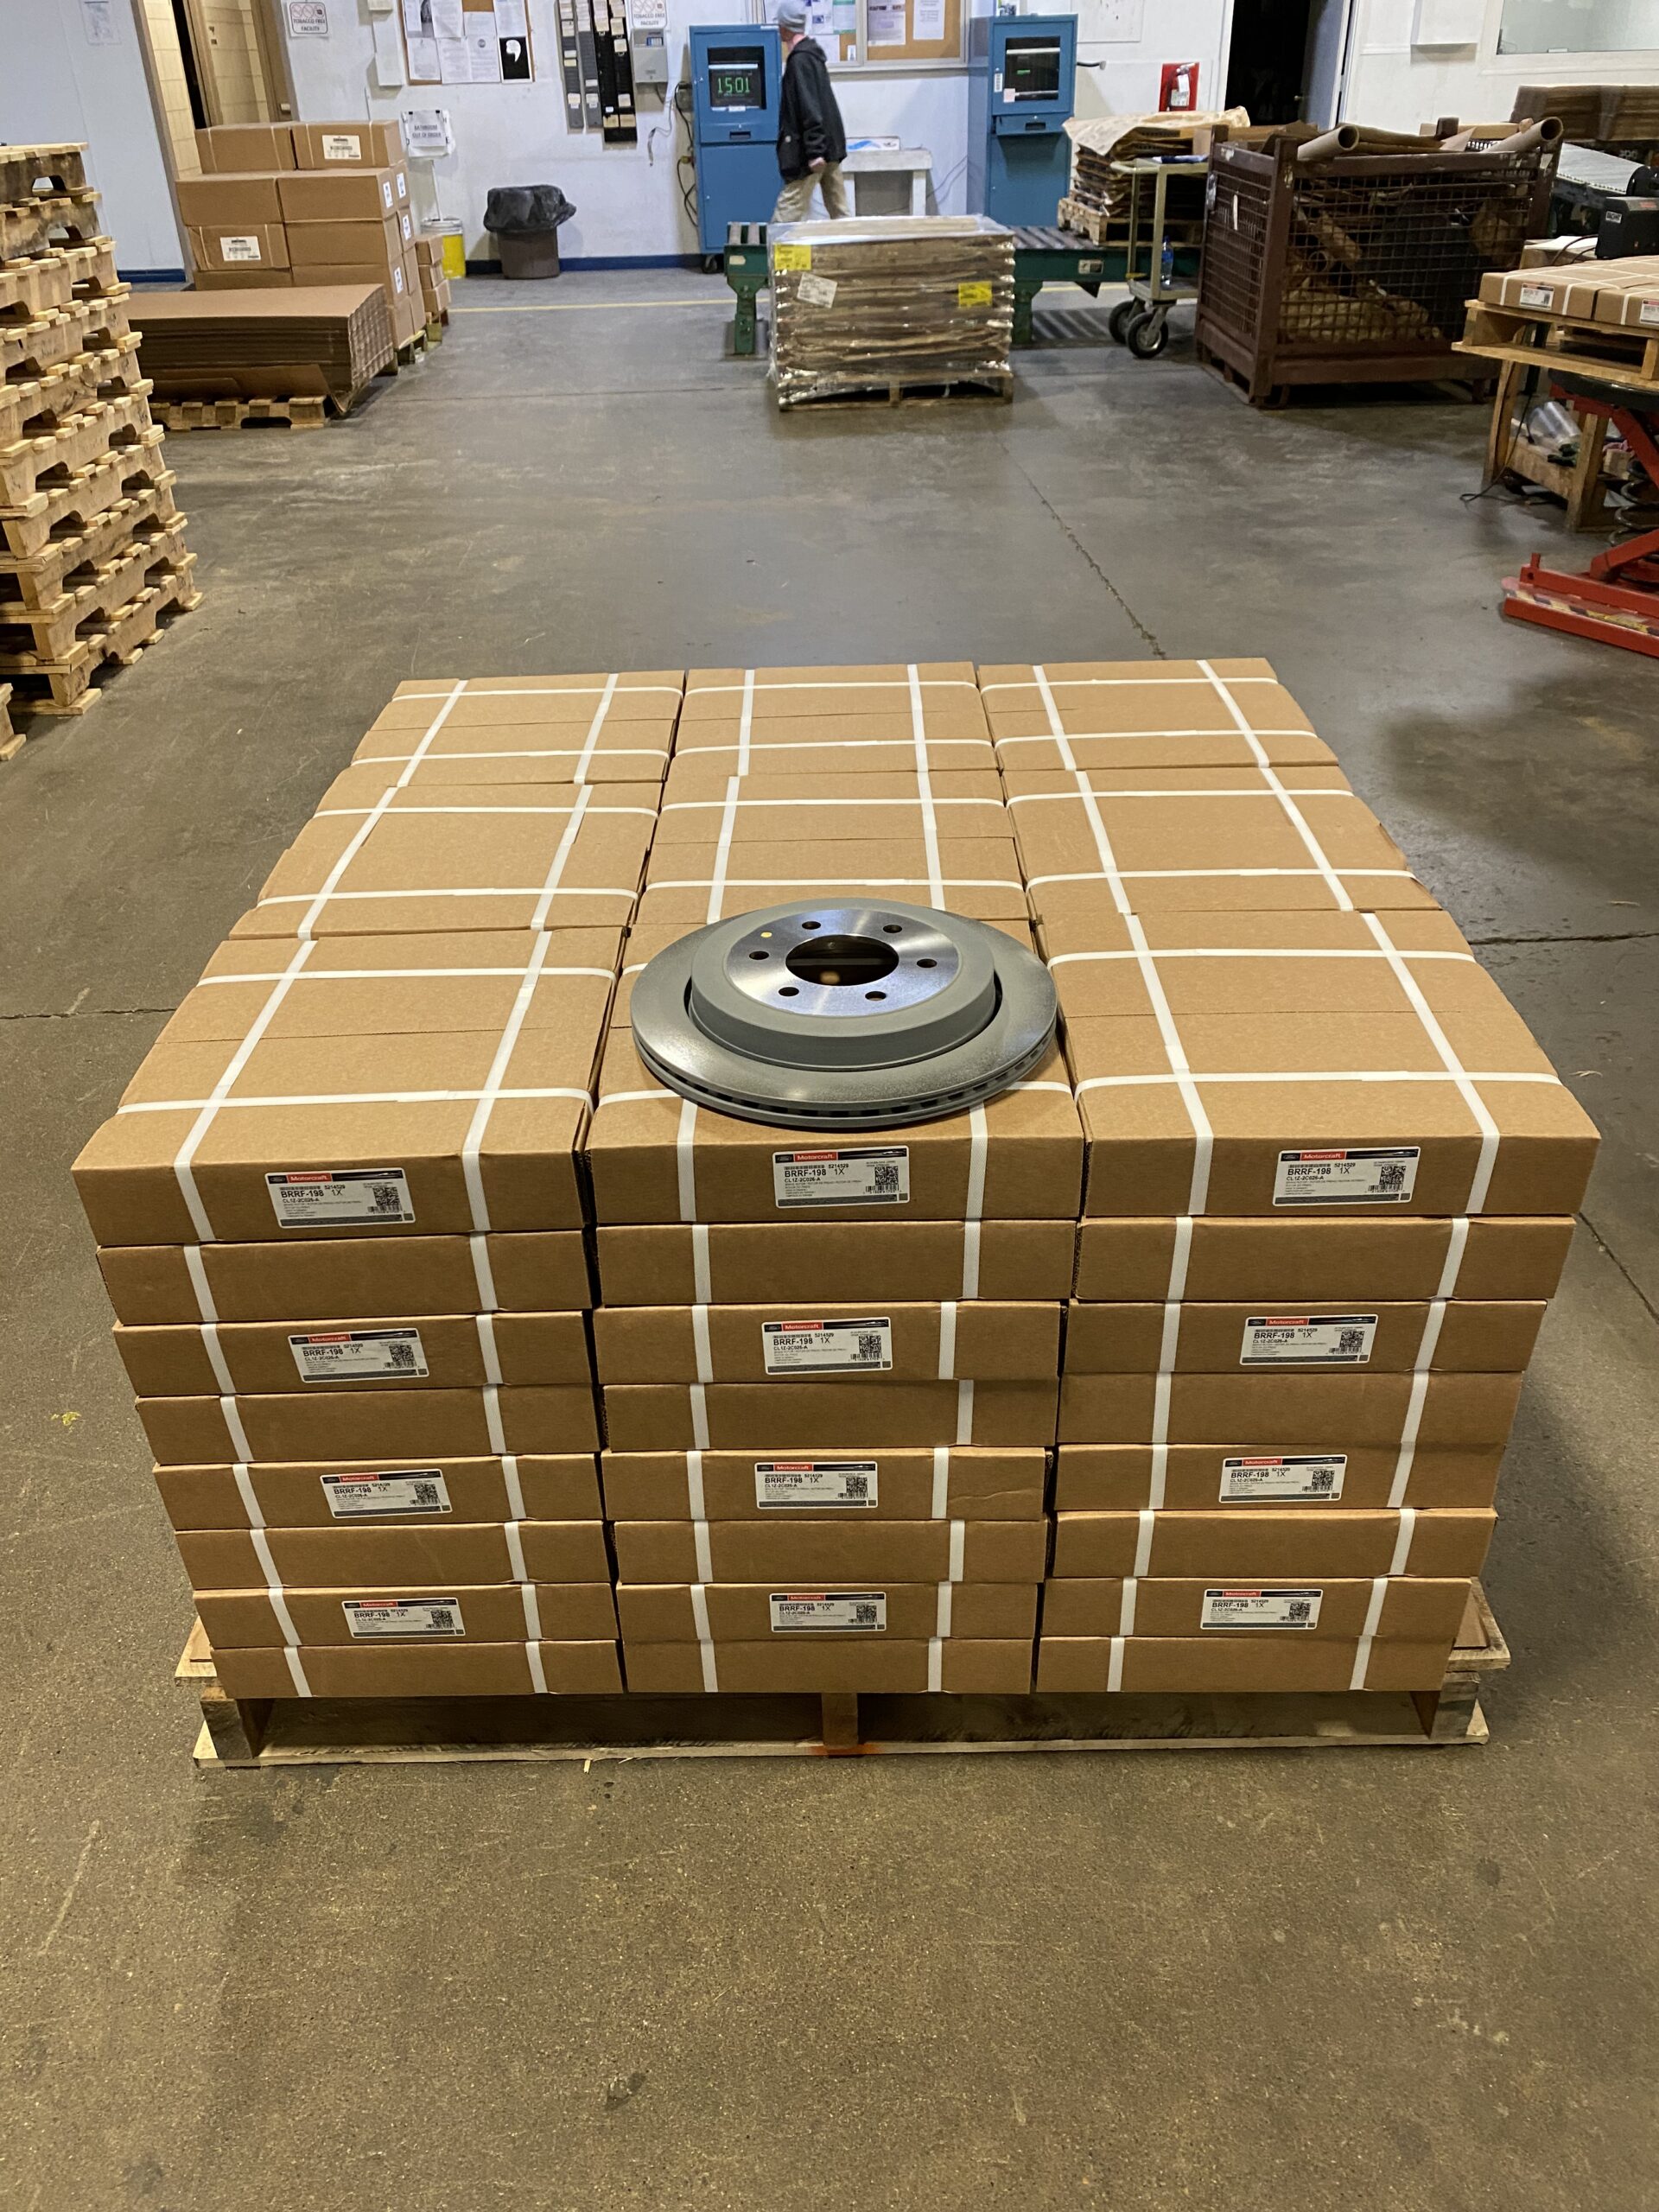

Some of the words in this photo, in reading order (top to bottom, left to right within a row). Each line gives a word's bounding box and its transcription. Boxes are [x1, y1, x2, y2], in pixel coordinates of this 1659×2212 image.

[718, 77, 750, 92] 1501
[784, 1168, 826, 1178] BRRF-198
[280, 1189, 324, 1198] BRRF-198
[302, 1348, 343, 1357] BRRF-198
